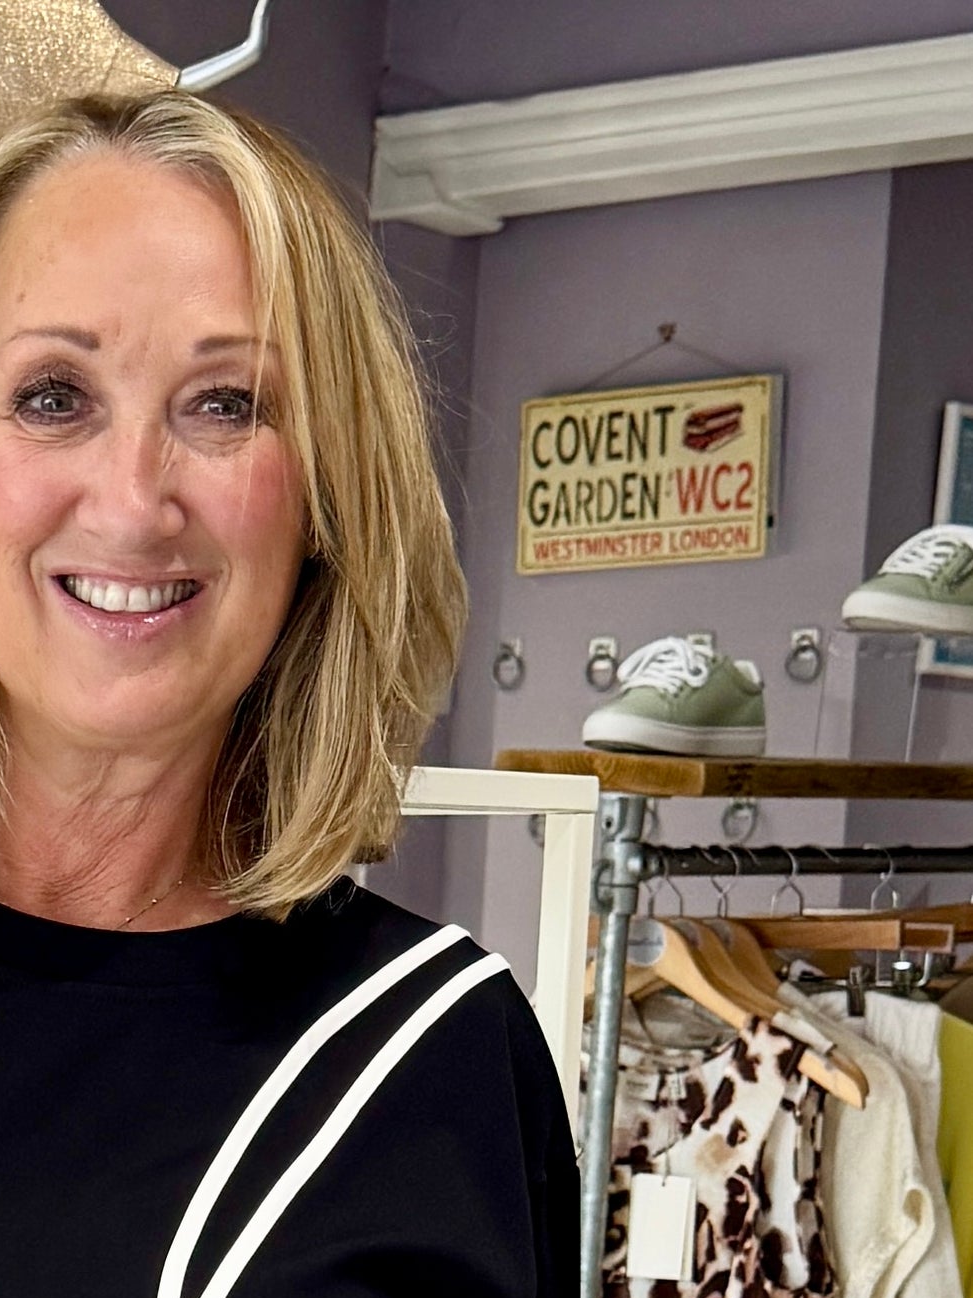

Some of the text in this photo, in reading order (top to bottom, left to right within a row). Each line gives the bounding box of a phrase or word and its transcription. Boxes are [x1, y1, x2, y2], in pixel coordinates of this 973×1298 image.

[532, 406, 675, 469] COVENT
[528, 461, 754, 528] GARDEN WC2
[533, 526, 750, 561] WESTMINSTER LONDON
